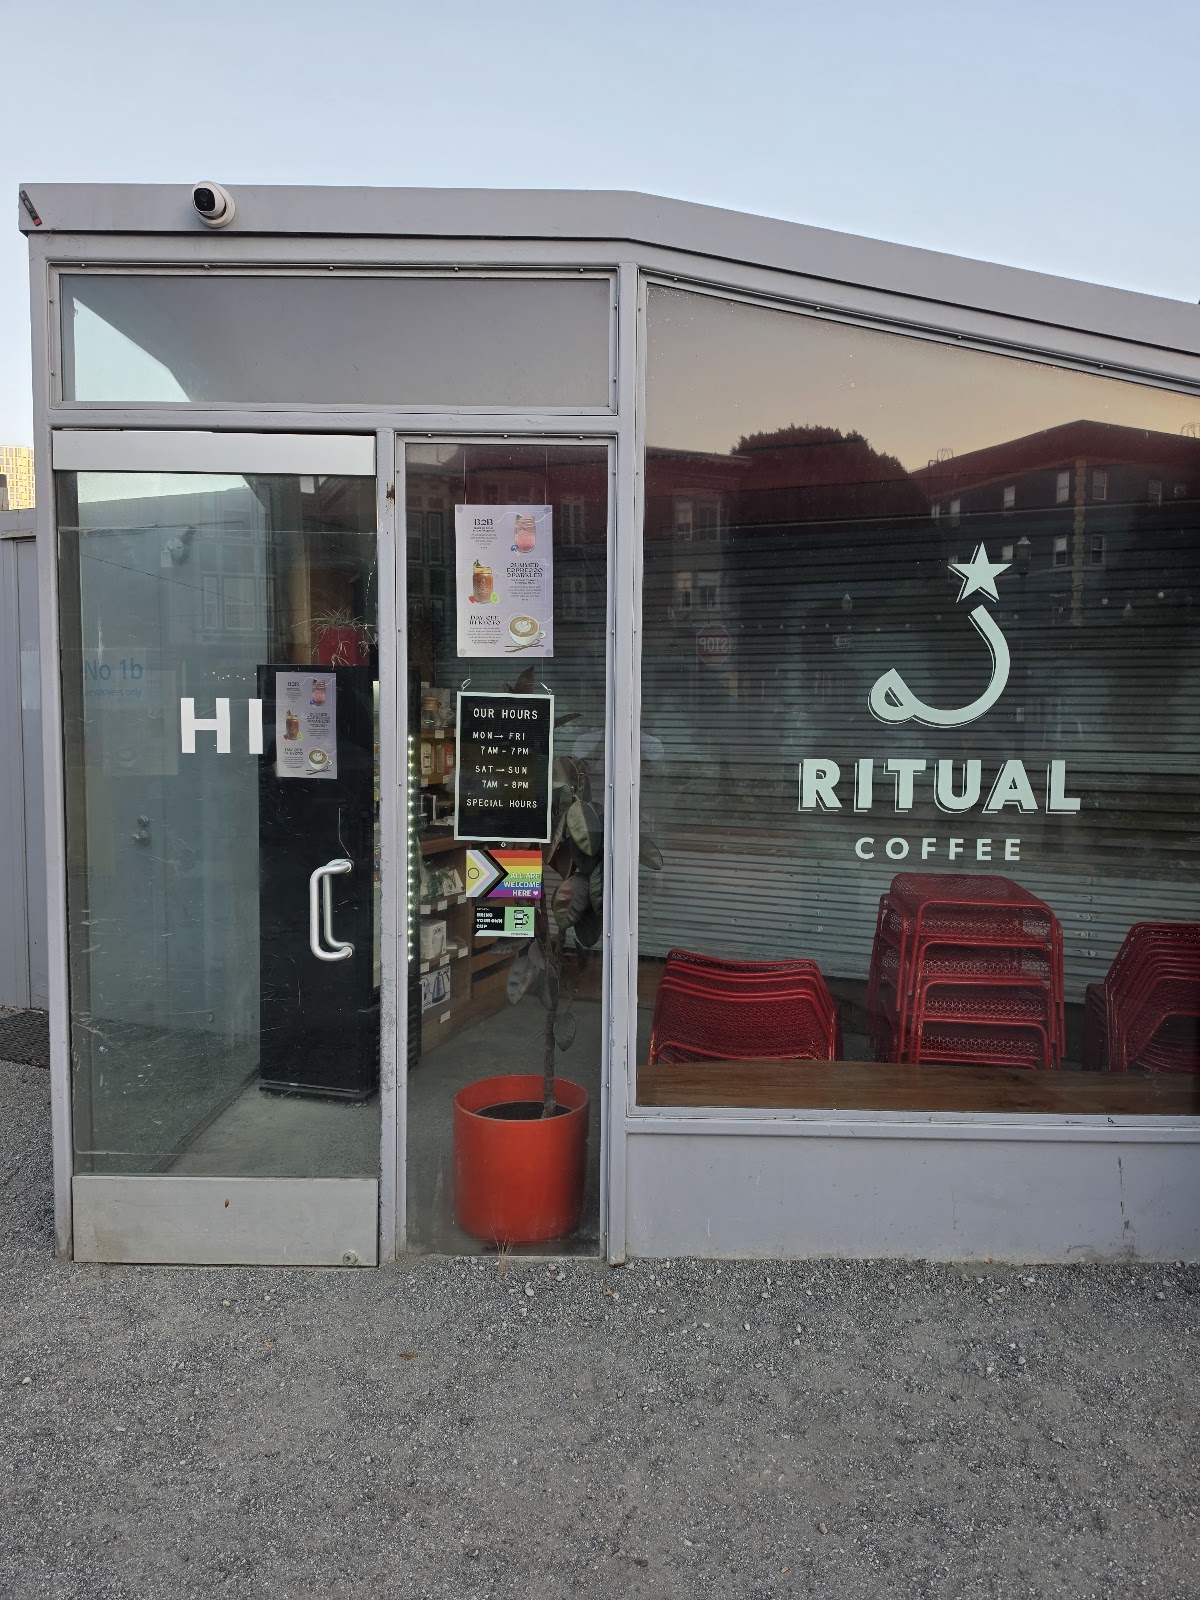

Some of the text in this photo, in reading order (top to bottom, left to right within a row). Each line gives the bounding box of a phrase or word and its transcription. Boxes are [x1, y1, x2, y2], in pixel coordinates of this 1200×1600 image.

[474, 518, 494, 526] B2B
[119, 657, 143, 680] 1b
[473, 707, 538, 720] OUR HOURS
[180, 697, 263, 754] HI
[472, 731, 526, 741] MON FRI
[475, 765, 528, 775] SAT SUN
[482, 780, 498, 789] 7AM
[511, 780, 529, 789] 8PM
[798, 758, 1081, 814] RITUAL
[466, 798, 538, 809] SPECIAL HOURS
[854, 837, 1022, 862] COFFEE
[512, 889, 532, 897] HERE
